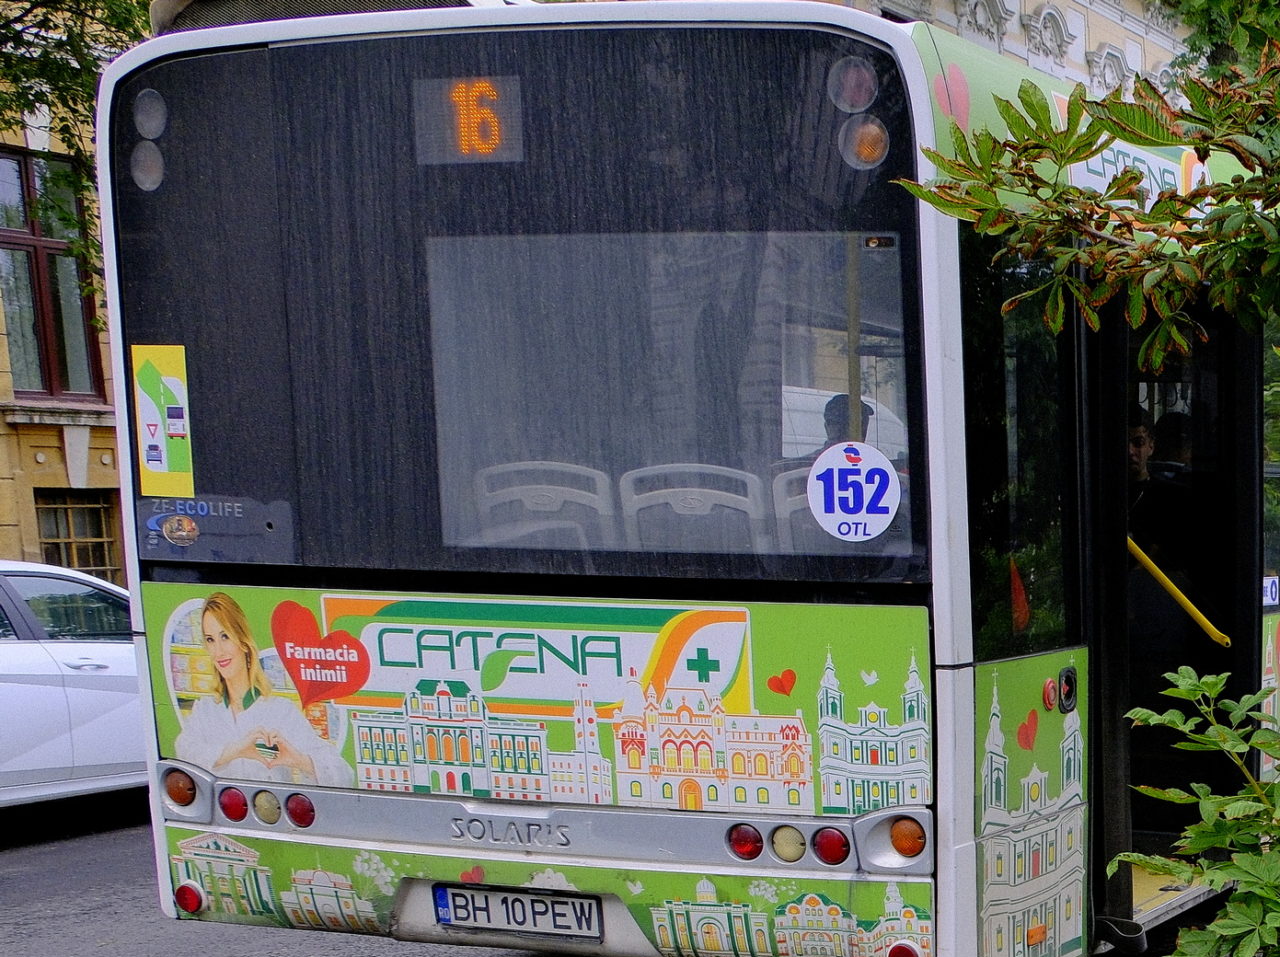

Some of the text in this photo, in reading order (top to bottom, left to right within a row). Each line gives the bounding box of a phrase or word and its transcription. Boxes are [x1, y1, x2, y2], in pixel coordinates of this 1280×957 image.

[452, 82, 499, 154] 16
[815, 467, 890, 515] 152
[151, 499, 243, 517] ZF-ECOLIFE
[837, 521, 872, 536] OTL
[284, 642, 359, 663] Farmacia
[377, 627, 624, 690] CATENA
[299, 663, 348, 684] inimii
[451, 817, 572, 849] SOLARIS
